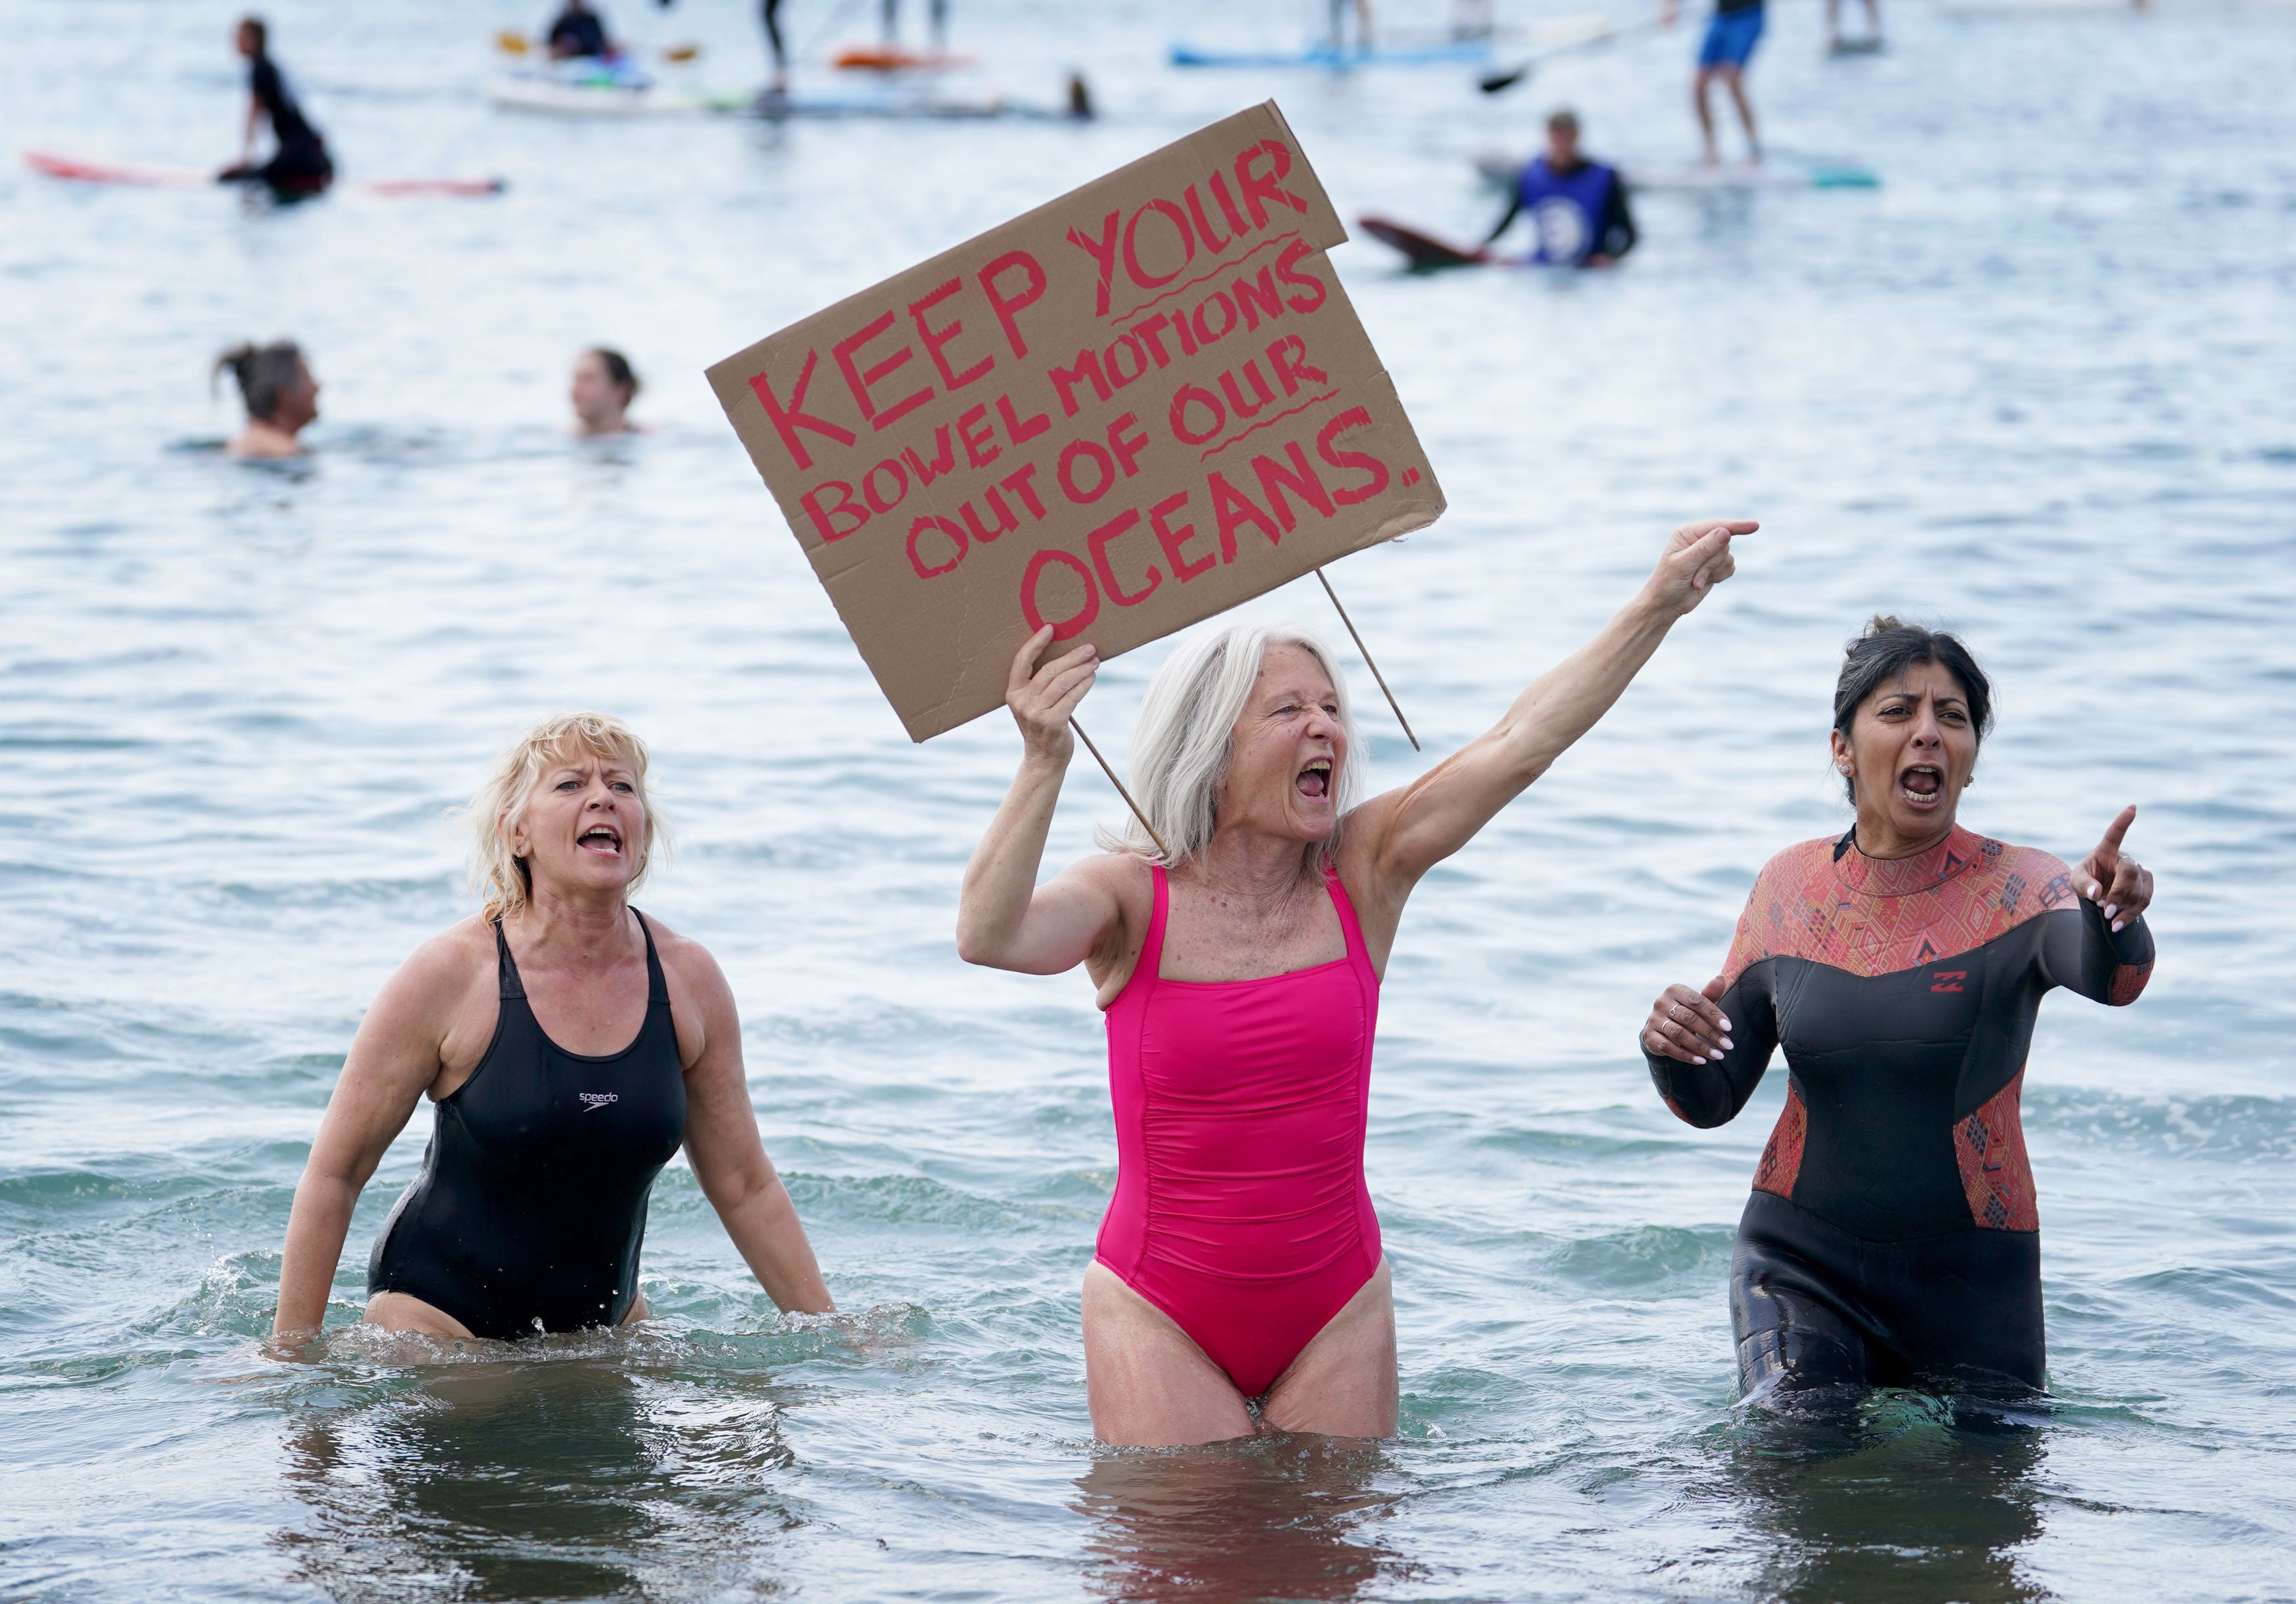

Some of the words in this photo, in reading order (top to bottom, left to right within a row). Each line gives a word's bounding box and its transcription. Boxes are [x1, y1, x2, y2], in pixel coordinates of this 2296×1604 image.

[749, 251, 1046, 470] KEEP
[1066, 138, 1307, 317] YOUR
[800, 394, 1051, 545] BOWEL
[1048, 238, 1326, 418] MOTIONS
[906, 463, 1046, 579] OUT
[1057, 412, 1149, 504] OF
[1169, 335, 1328, 445] OUR
[1020, 407, 1420, 641] OCEANS.
[579, 1092, 619, 1103] speedo
